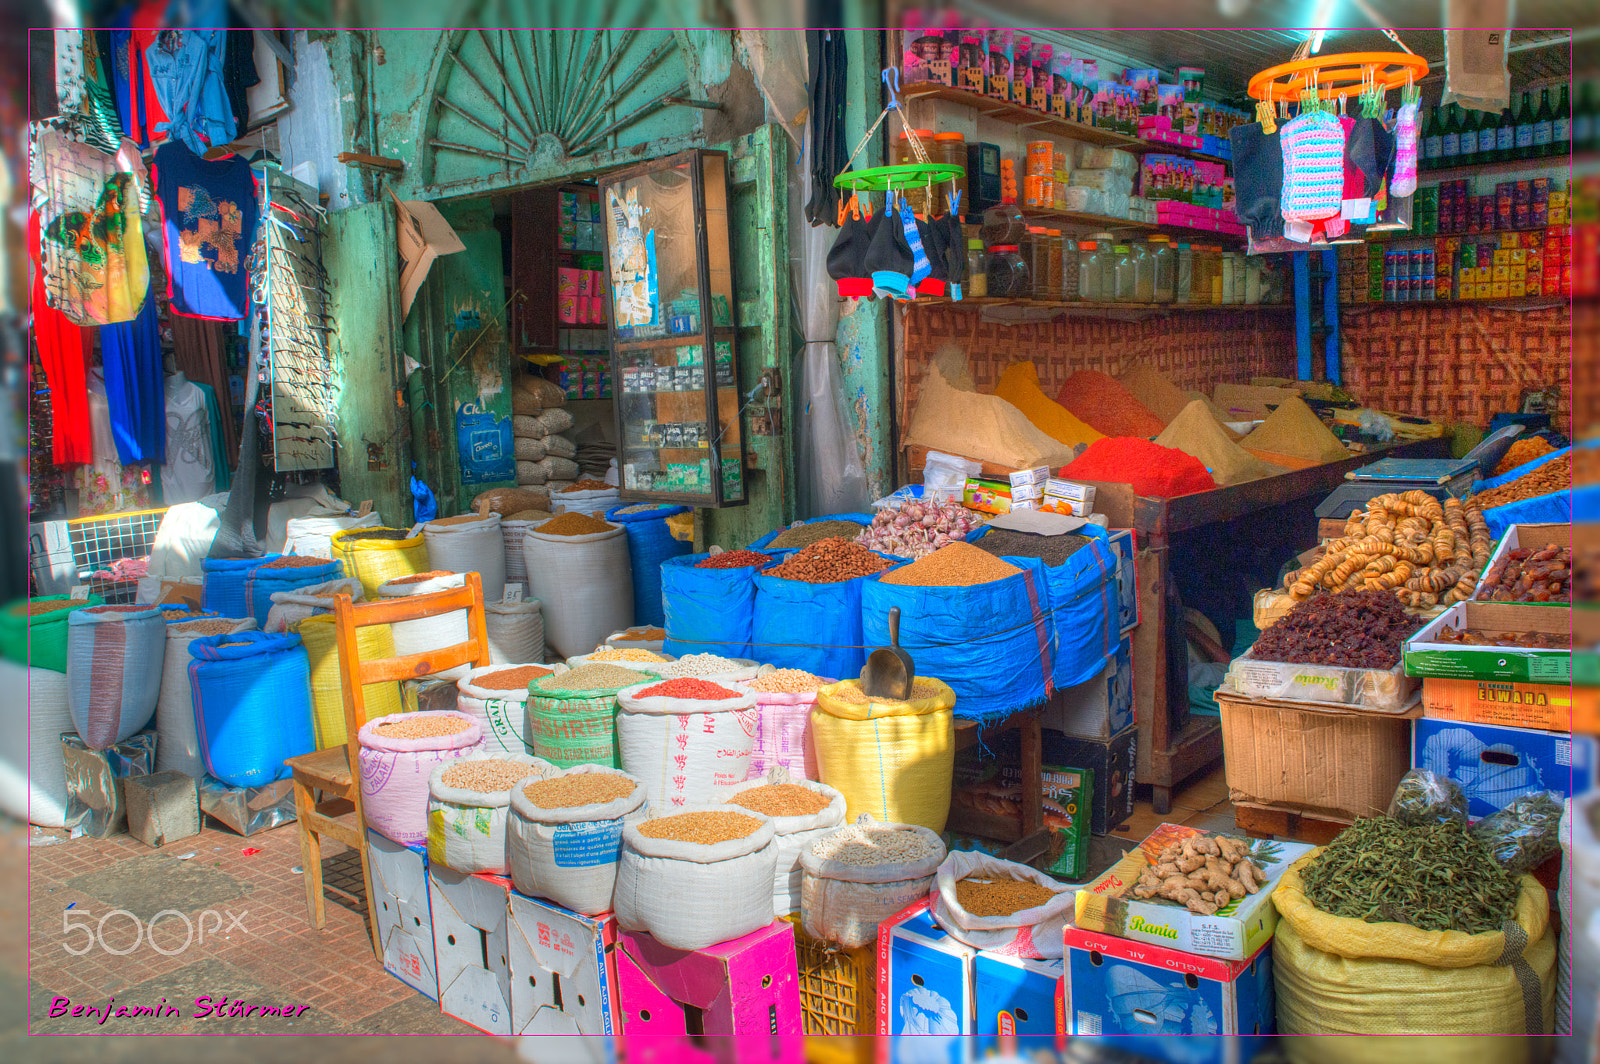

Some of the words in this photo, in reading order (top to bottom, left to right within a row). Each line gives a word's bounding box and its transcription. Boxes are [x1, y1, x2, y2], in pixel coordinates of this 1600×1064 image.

[540, 698, 555, 711] OF
[558, 695, 616, 714] QUALITY
[1478, 688, 1548, 706] ELWAHA
[369, 763, 391, 791] FALAH
[1128, 915, 1179, 940] Rania
[1084, 940, 1108, 951] AJO
[1127, 949, 1145, 960] AIL
[1166, 959, 1206, 973] AGLIO
